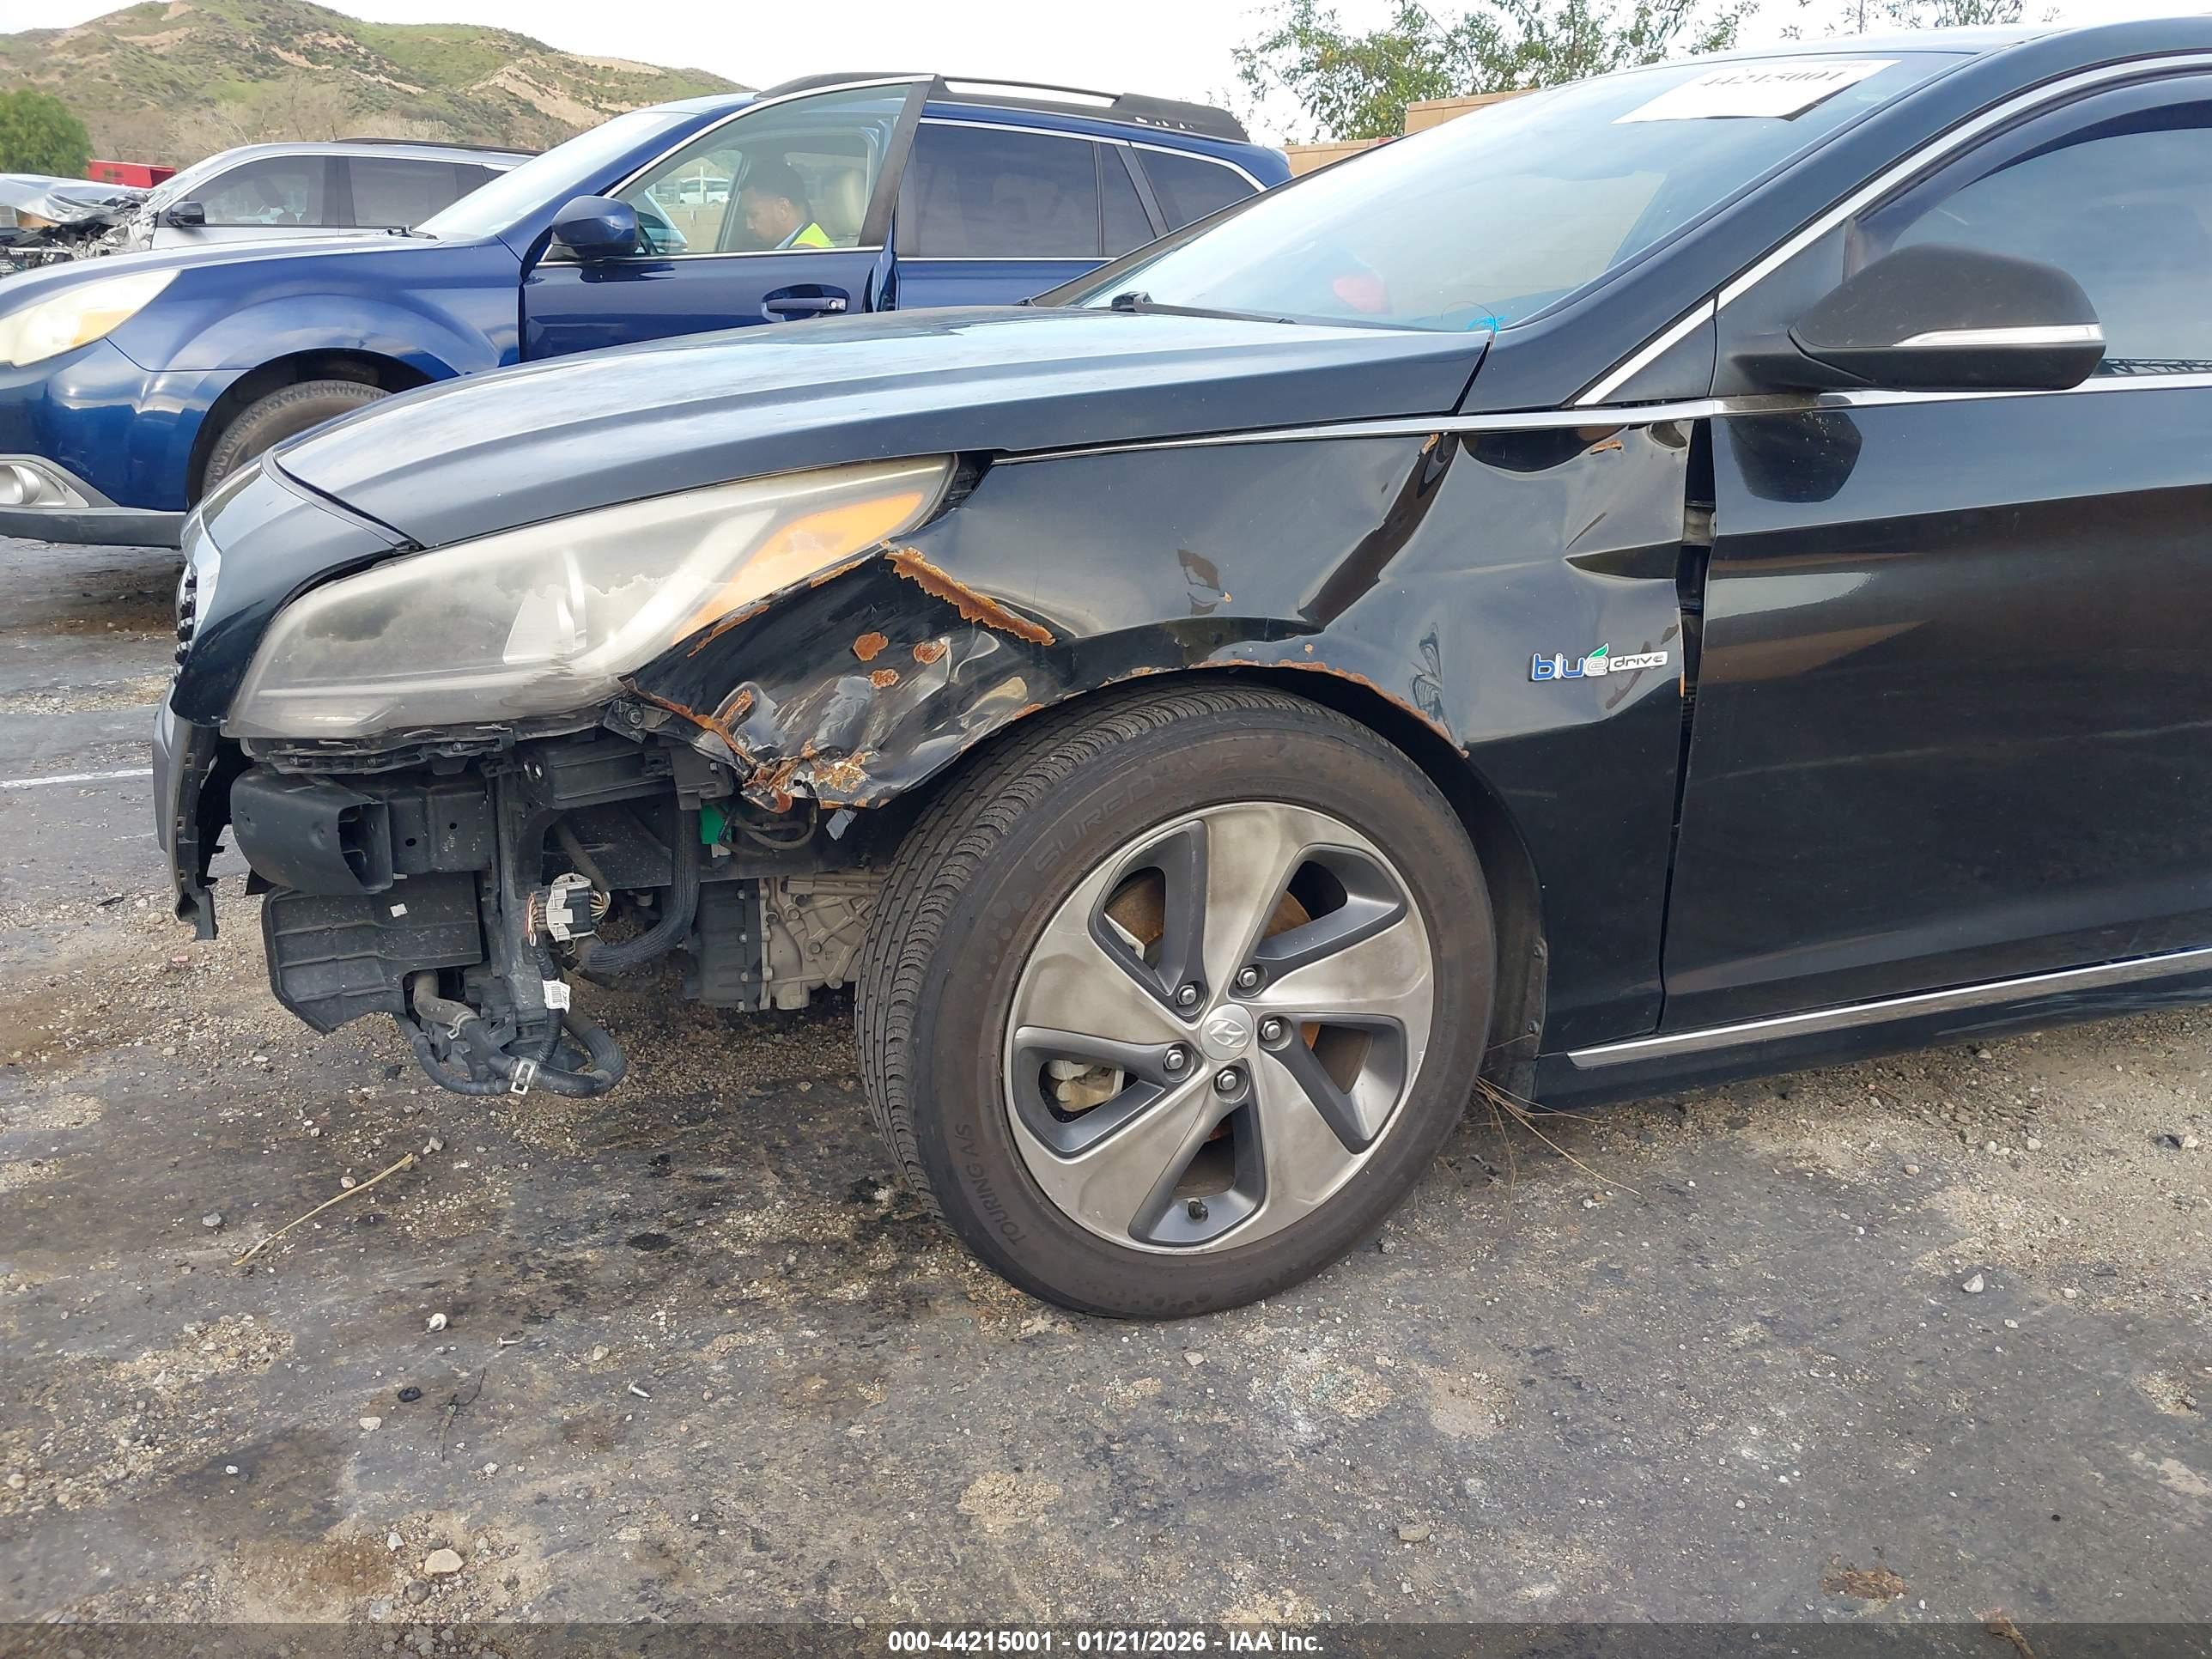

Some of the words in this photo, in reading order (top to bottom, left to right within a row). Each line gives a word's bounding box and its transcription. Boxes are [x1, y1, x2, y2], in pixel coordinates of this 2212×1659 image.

[1532, 650, 1609, 681] blue
[1613, 653, 1665, 669] drive
[954, 1122, 981, 1158] A/S
[966, 1162, 1027, 1246] TOURING
